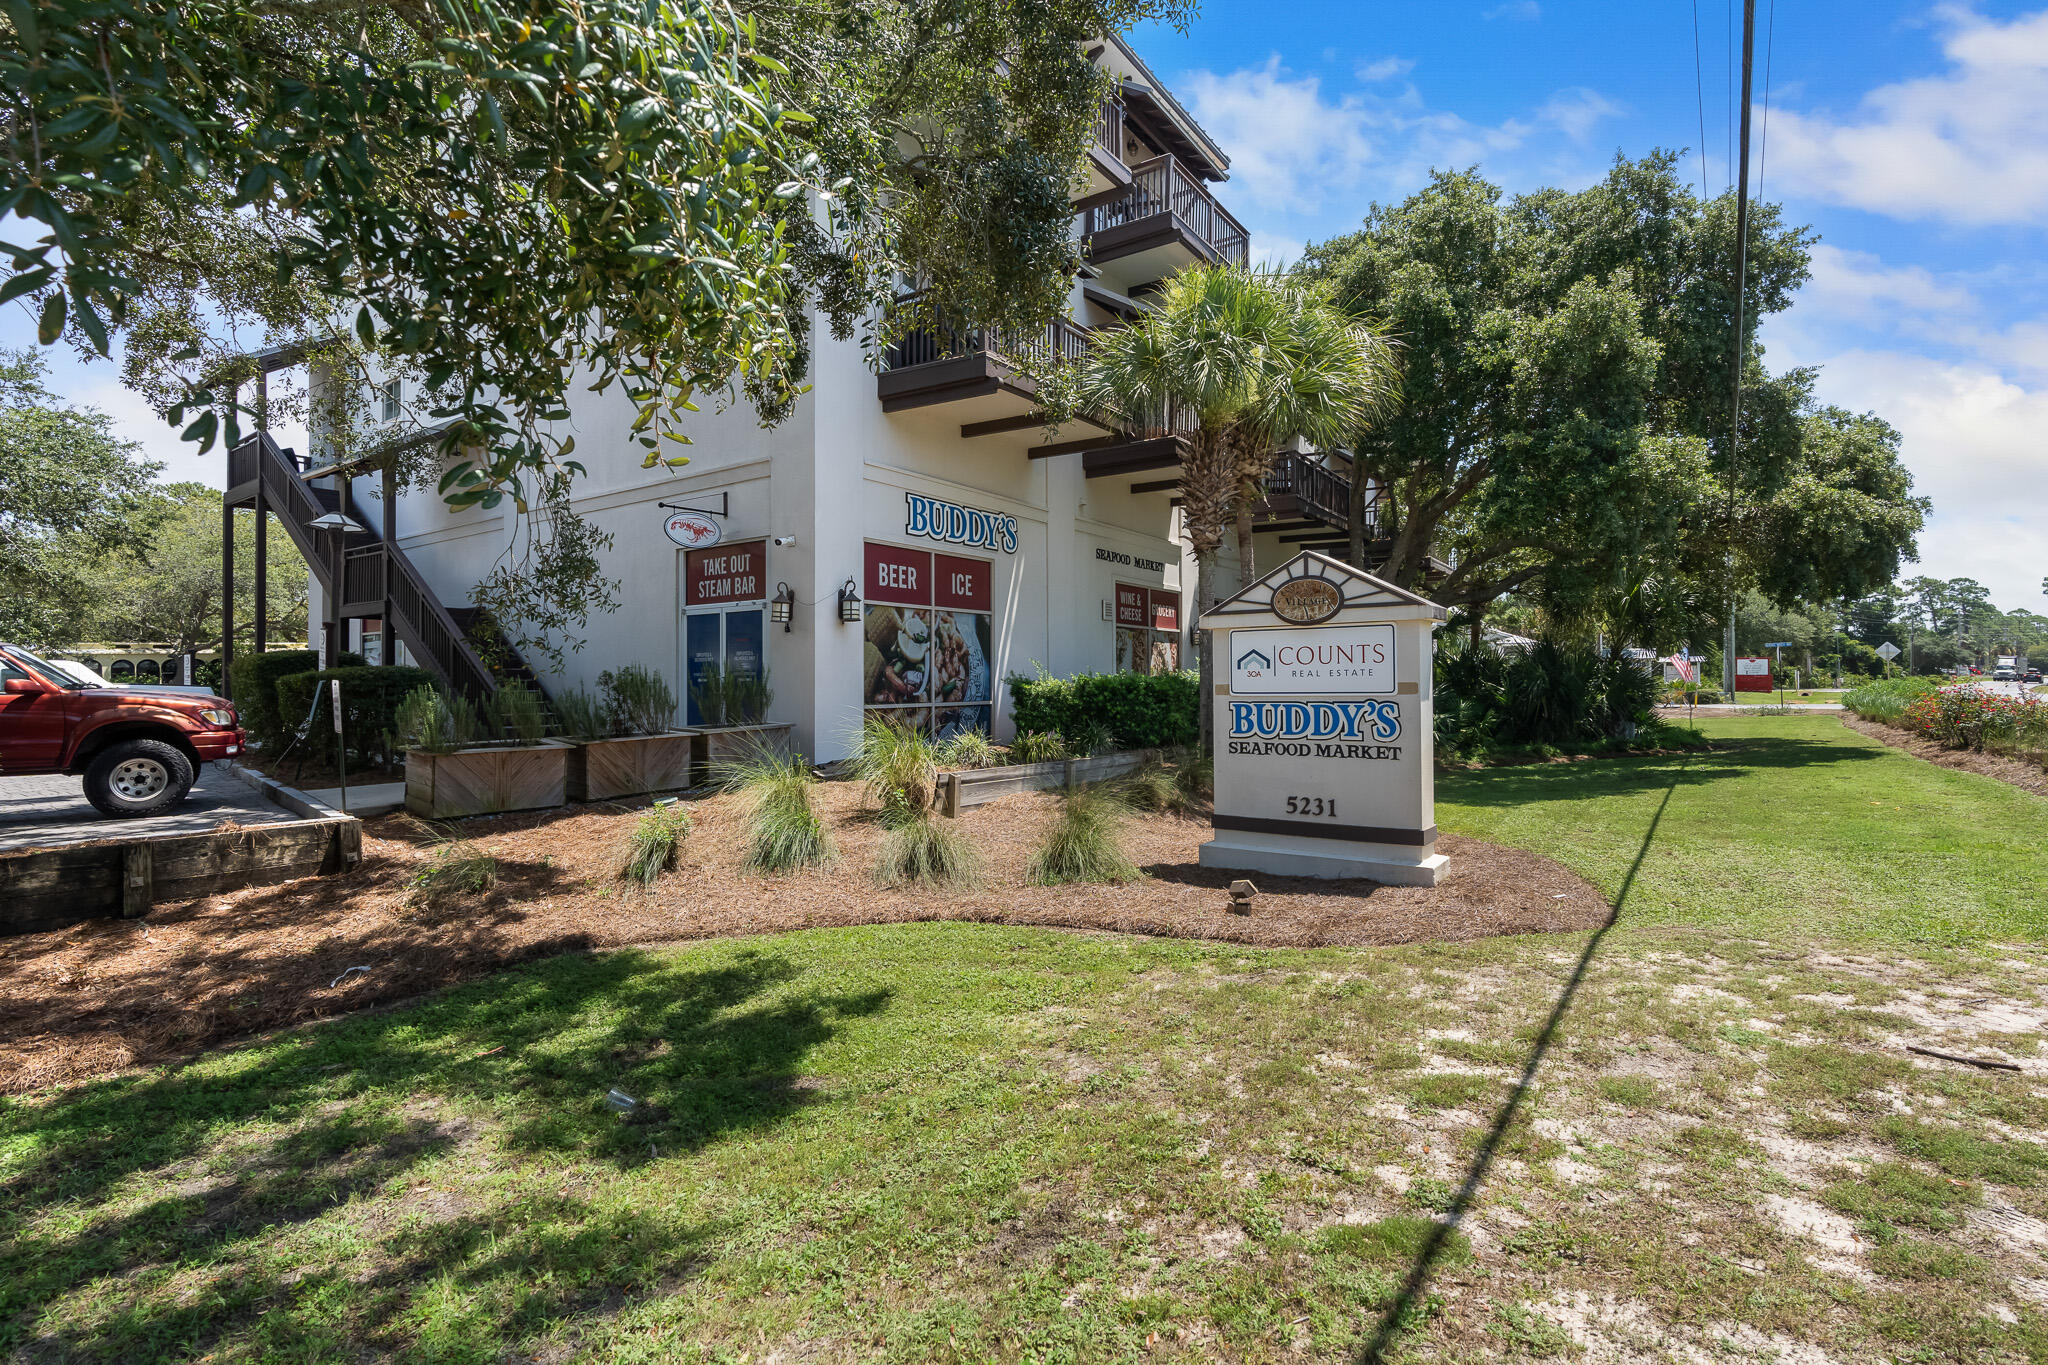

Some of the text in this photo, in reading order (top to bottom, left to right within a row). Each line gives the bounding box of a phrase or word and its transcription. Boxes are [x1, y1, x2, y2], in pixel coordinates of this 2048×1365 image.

[906, 492, 1018, 553] BUDDY'S
[703, 554, 751, 576] TAKE OUT
[1096, 548, 1165, 572] SEAFOOD MARKET
[698, 576, 756, 598] STEAM BAR
[878, 562, 973, 596] BEER ICE
[1120, 591, 1142, 606] WINE &
[1120, 606, 1142, 622] CHEESE
[1278, 643, 1385, 666] COUNTS
[1291, 668, 1374, 678] REAL ESTATE
[1229, 700, 1401, 742] BUDDY'S
[1228, 741, 1402, 761] SEAFOOD MARKET
[1286, 796, 1337, 817] 5231
